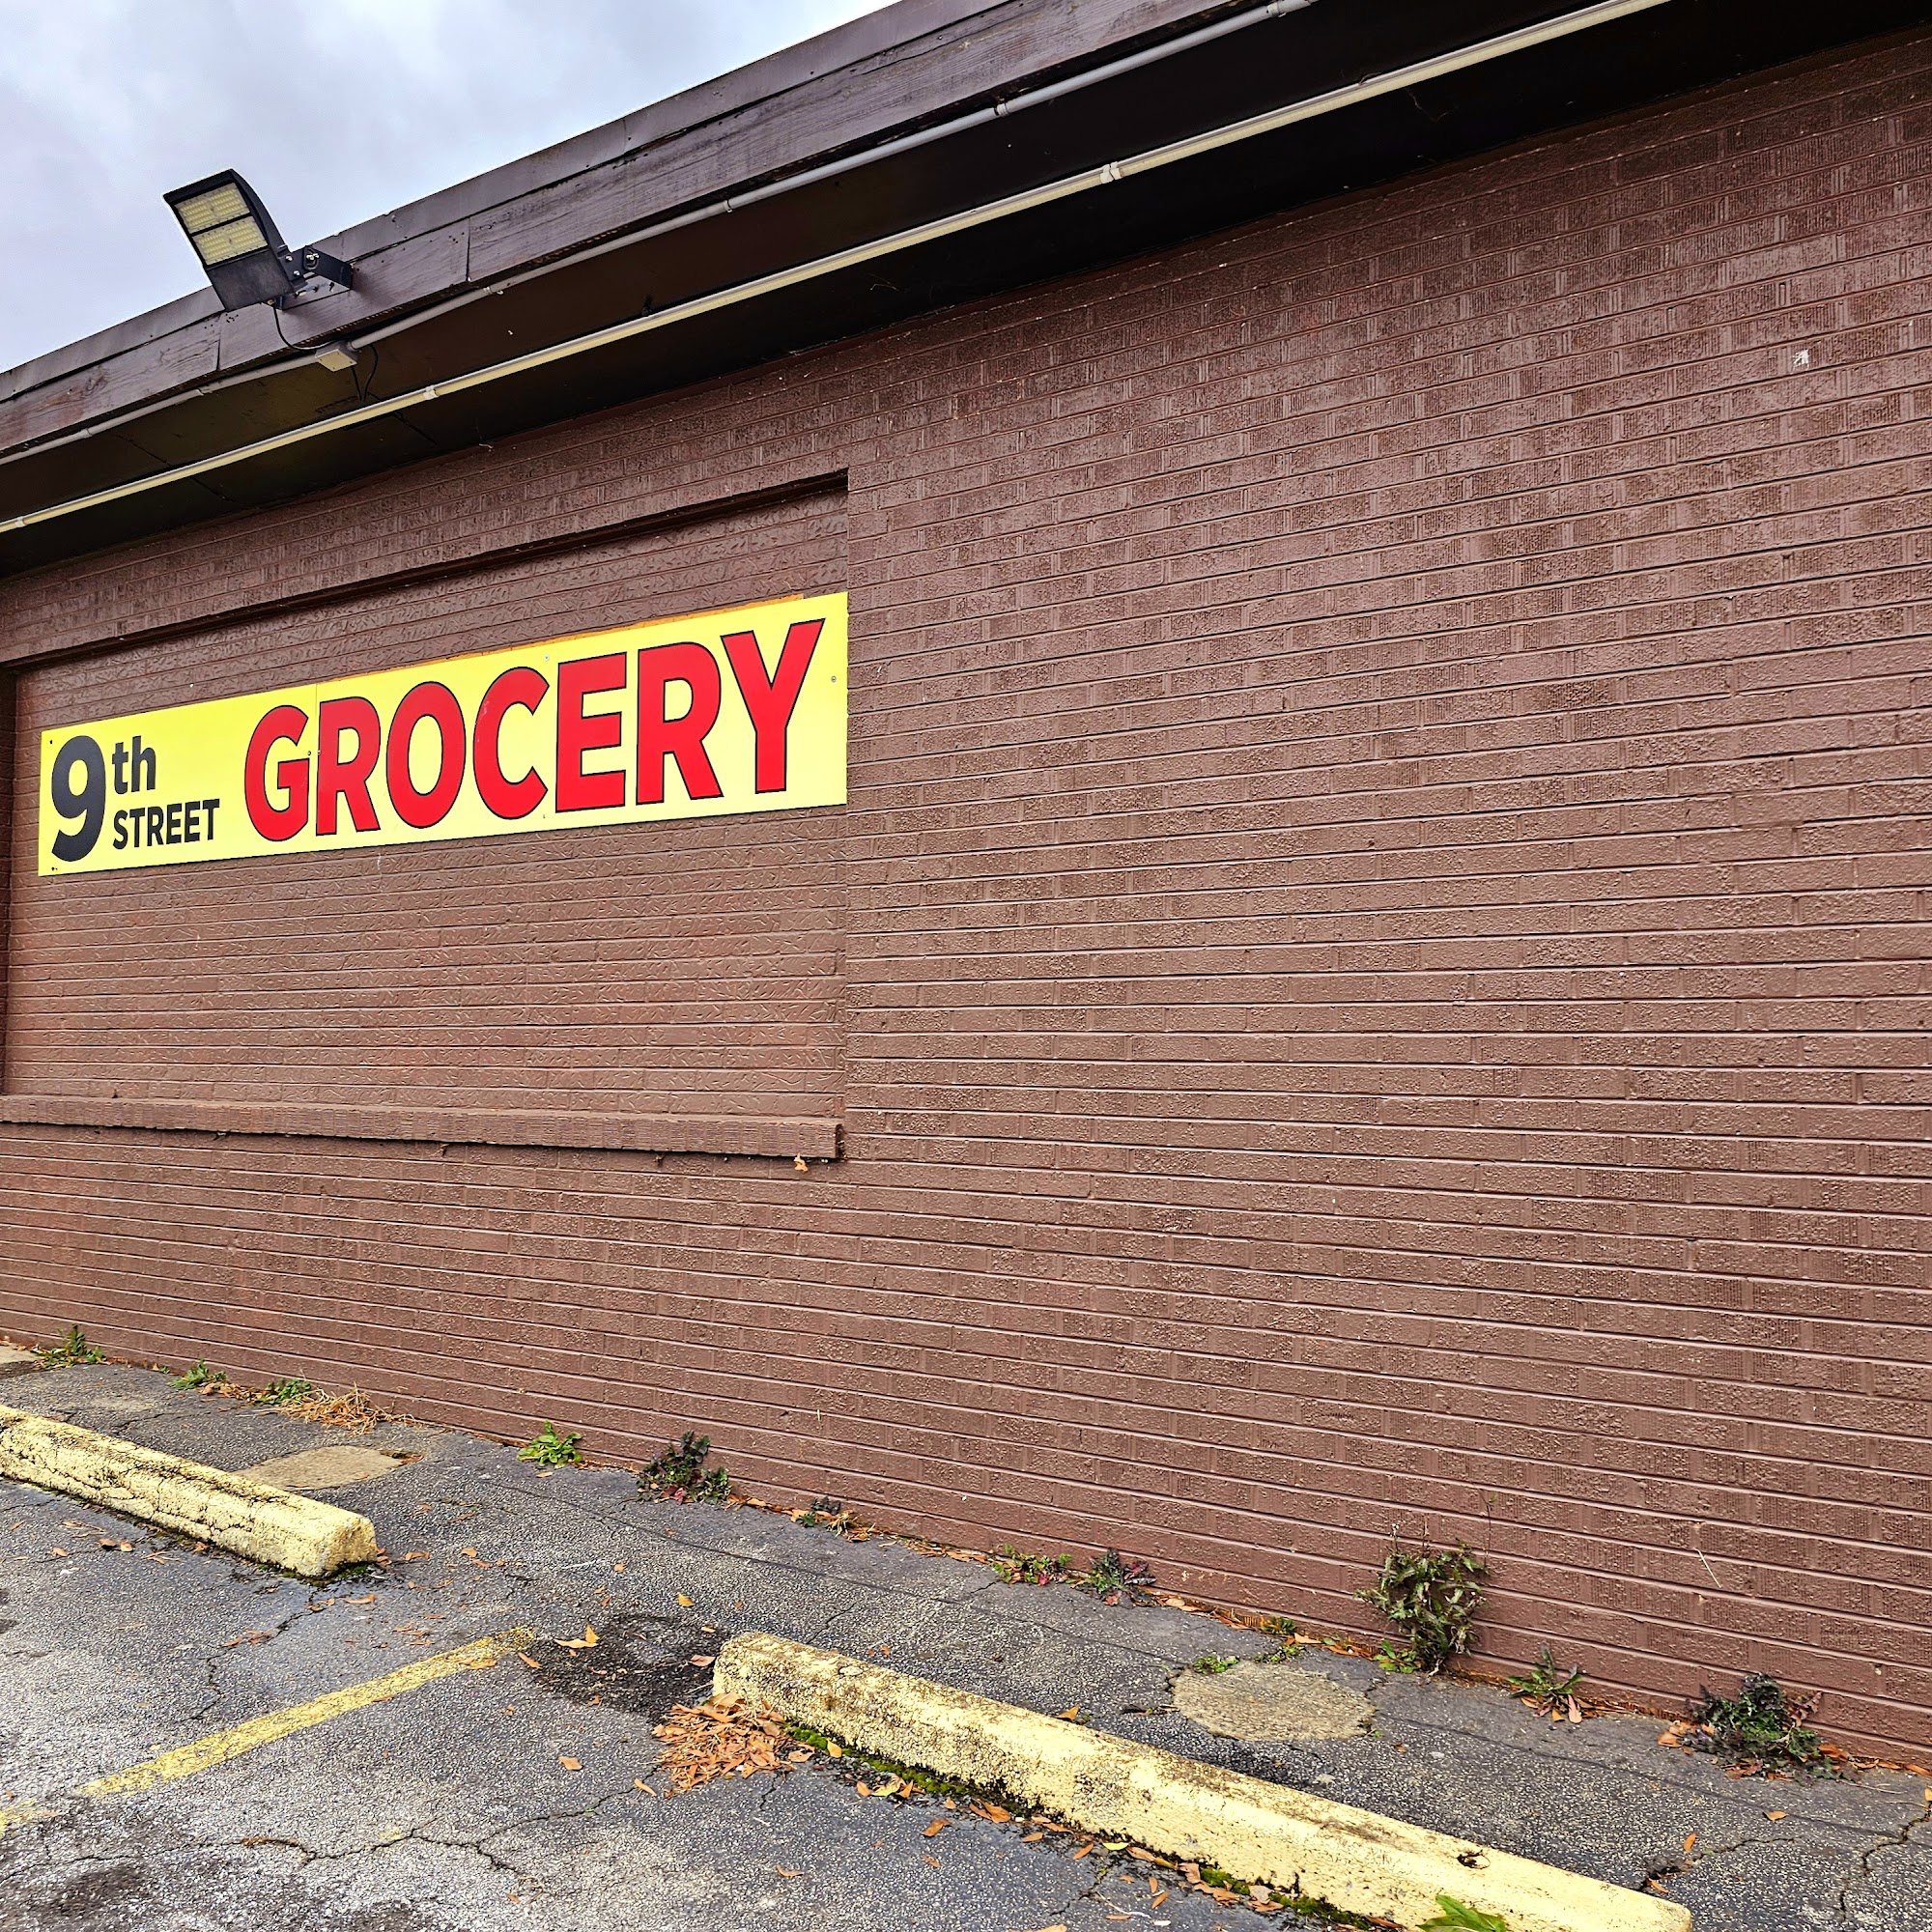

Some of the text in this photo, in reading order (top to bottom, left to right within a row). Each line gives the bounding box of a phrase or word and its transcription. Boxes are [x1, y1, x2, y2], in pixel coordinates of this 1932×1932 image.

[244, 618, 825, 841] GROCERY
[51, 735, 156, 863] 9th
[112, 799, 220, 850] STREET
